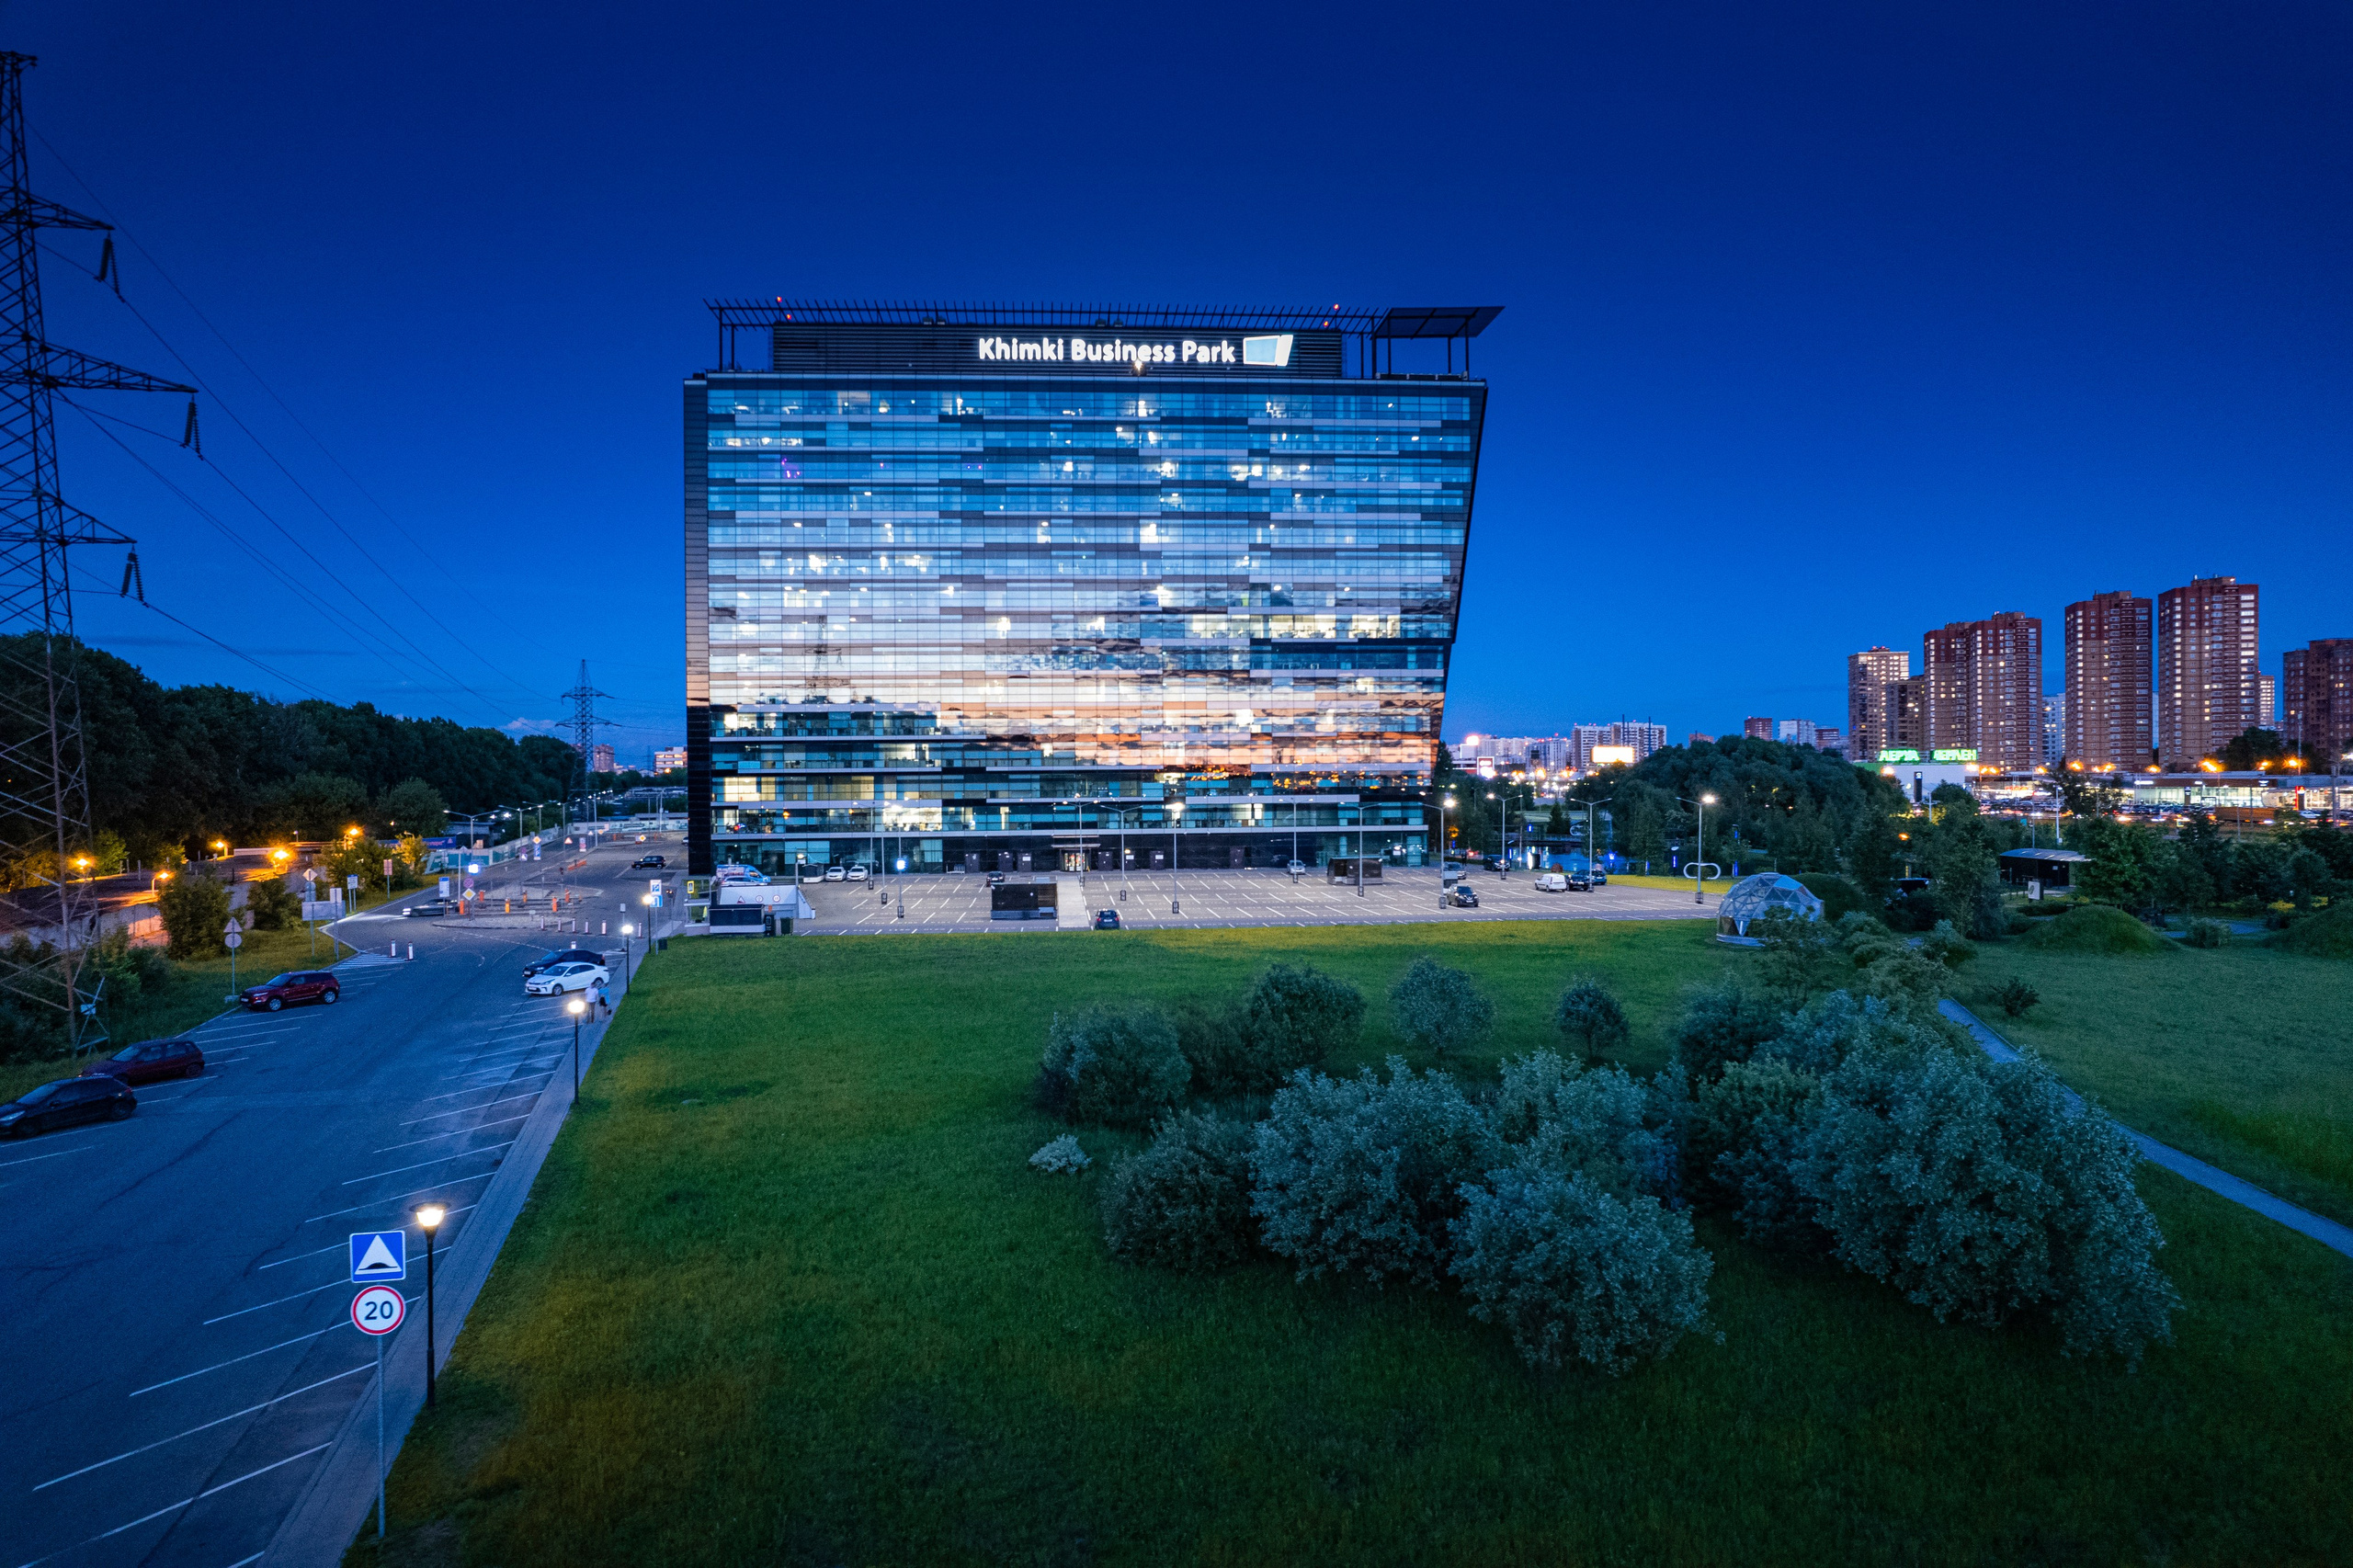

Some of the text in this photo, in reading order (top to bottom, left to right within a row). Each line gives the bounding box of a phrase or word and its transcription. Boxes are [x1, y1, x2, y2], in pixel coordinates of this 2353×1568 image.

[979, 337, 1235, 363] Khimki Business Park
[364, 1301, 393, 1321] 20
